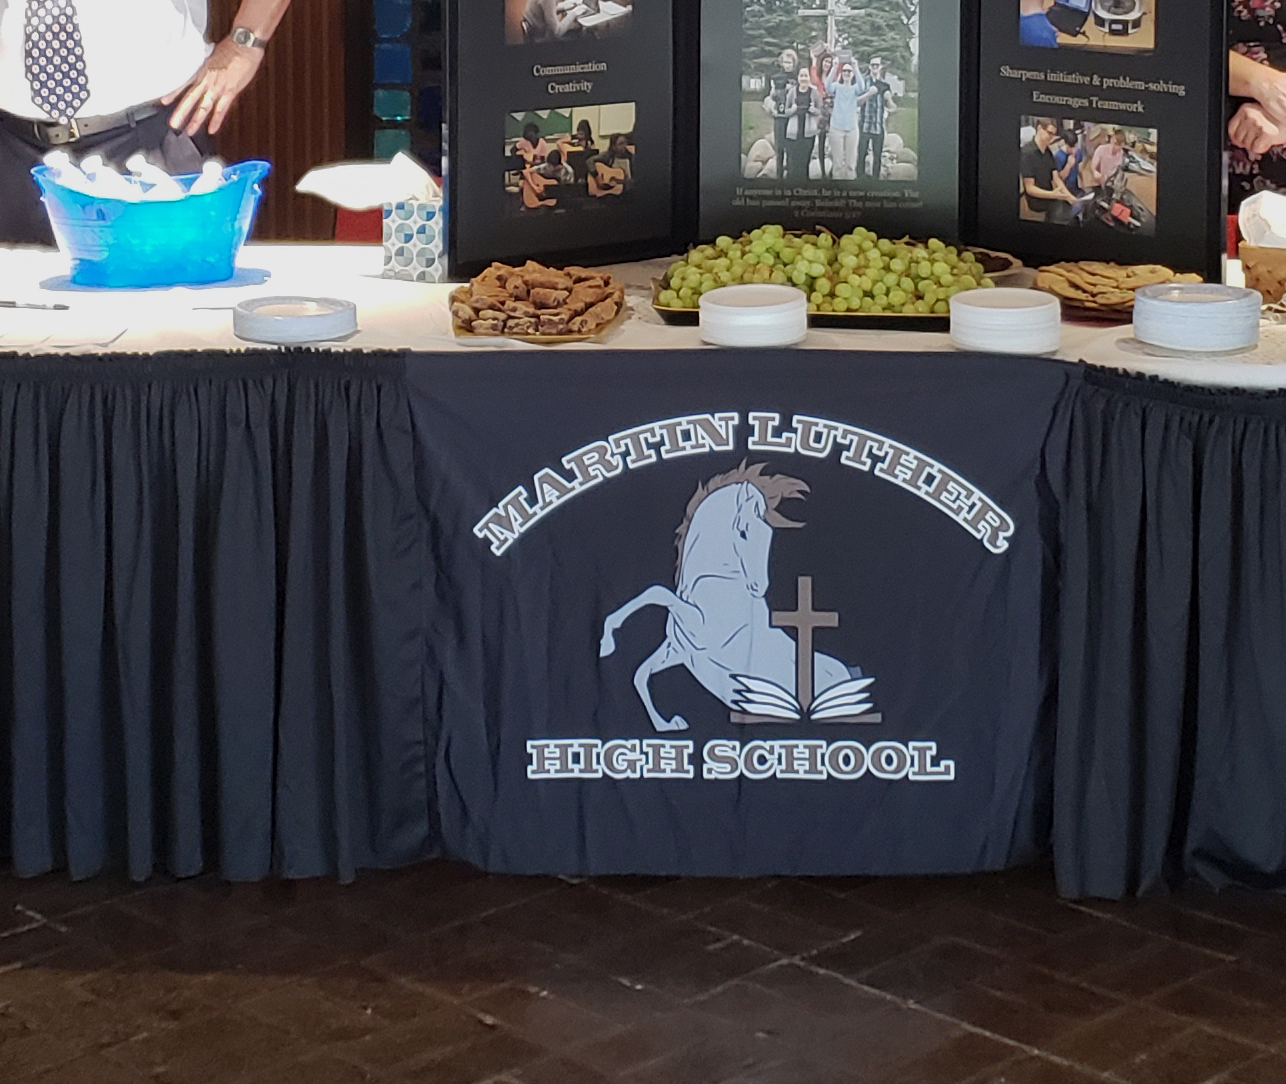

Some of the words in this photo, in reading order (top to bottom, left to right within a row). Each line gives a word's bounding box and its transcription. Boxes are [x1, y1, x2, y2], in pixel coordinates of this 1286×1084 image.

[533, 61, 607, 76] Communication
[1000, 65, 1045, 82] Sharpens
[1047, 69, 1090, 85] initiative
[1092, 74, 1101, 85] &
[1103, 76, 1186, 96] problem-solving
[547, 79, 593, 94] Creativity
[1032, 90, 1089, 108] Encourages
[1090, 96, 1145, 113] Teamwork
[473, 412, 739, 556] MARTIN
[747, 412, 1017, 554] LUTHER
[526, 739, 695, 780] HIGH
[703, 740, 955, 781] SCHOOL
